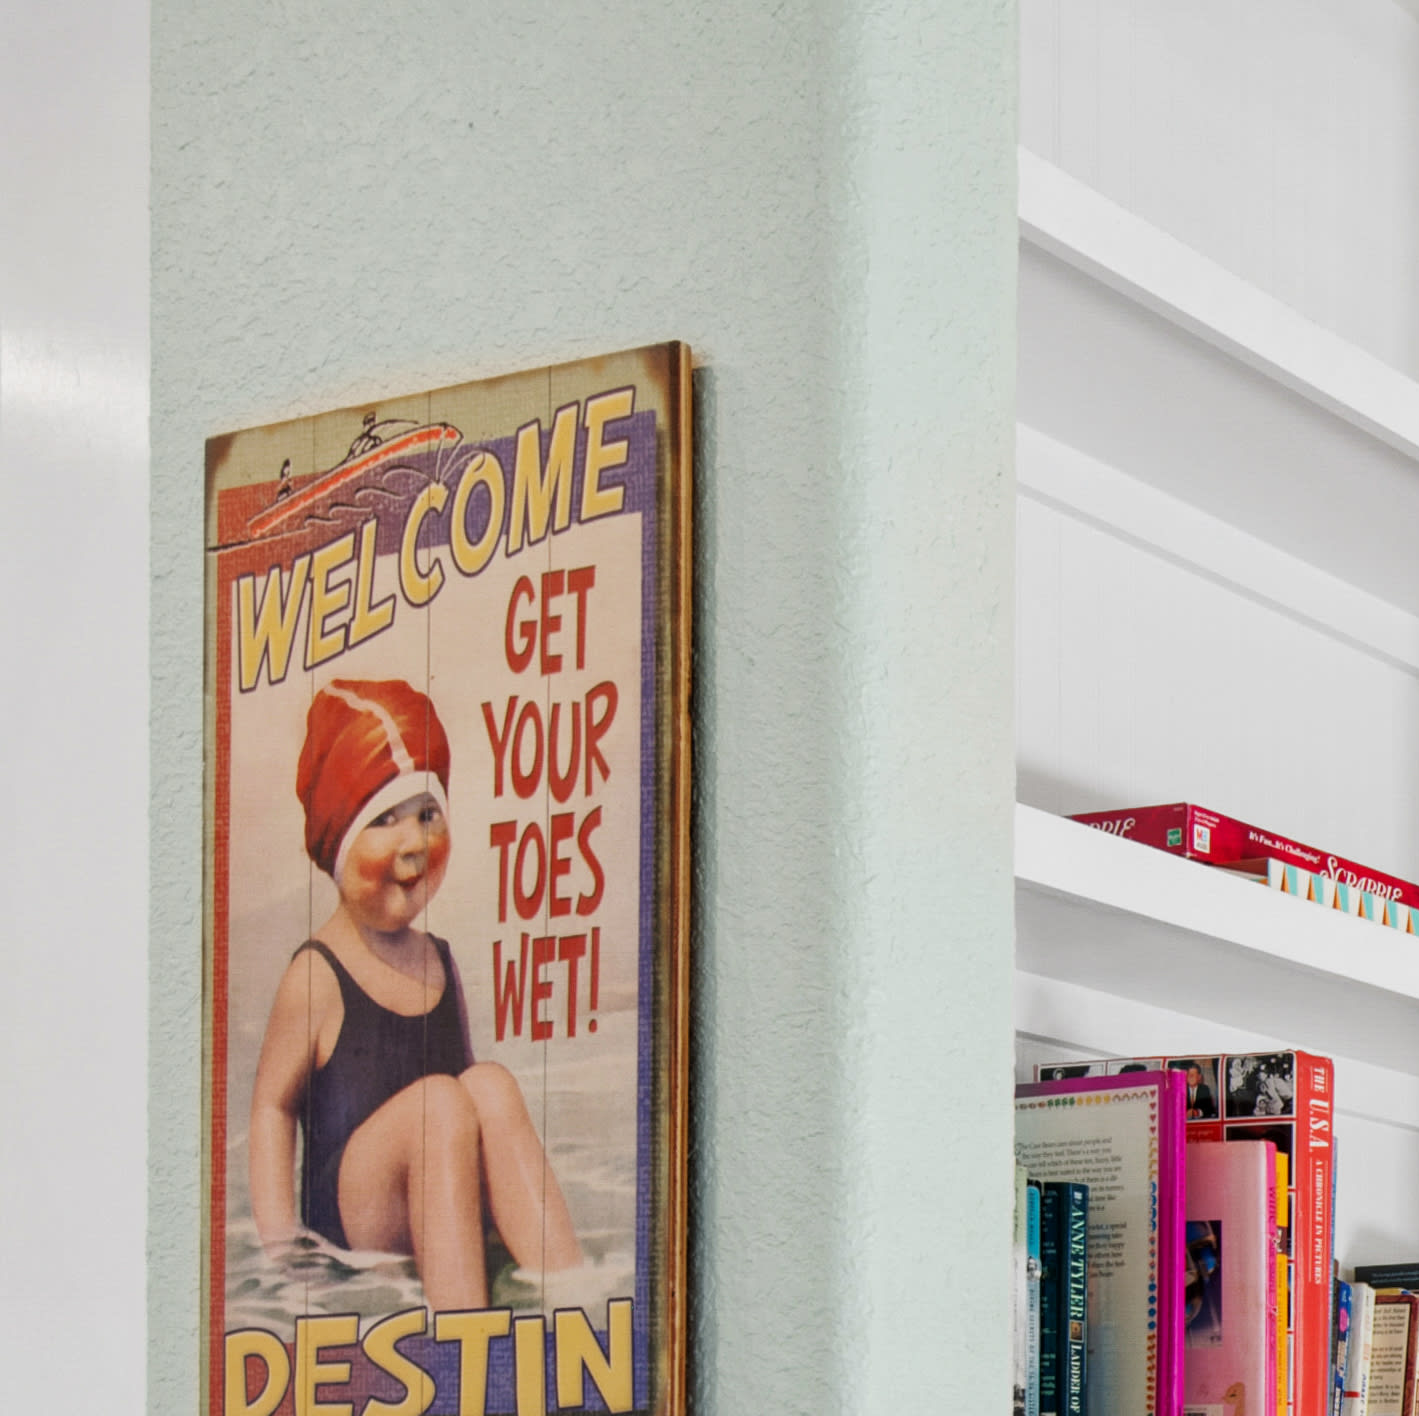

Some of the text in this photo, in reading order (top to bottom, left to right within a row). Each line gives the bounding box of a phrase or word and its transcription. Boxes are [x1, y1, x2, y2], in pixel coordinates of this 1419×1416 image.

[238, 386, 636, 694] WELCOME
[504, 565, 596, 677] GET
[481, 681, 619, 803] YOUR
[490, 805, 605, 923] TOES
[493, 927, 600, 1042] WET!
[1308, 1066, 1331, 1153] THE U.S.A.
[1314, 1168, 1324, 1222] CHRONICLE
[1314, 1225, 1324, 1235] IN
[1070, 1205, 1085, 1318] ANNE TYLER
[1313, 1238, 1324, 1285] PICTURES
[1070, 1344, 1083, 1394] LADDER
[1070, 1396, 1081, 1411] OF
